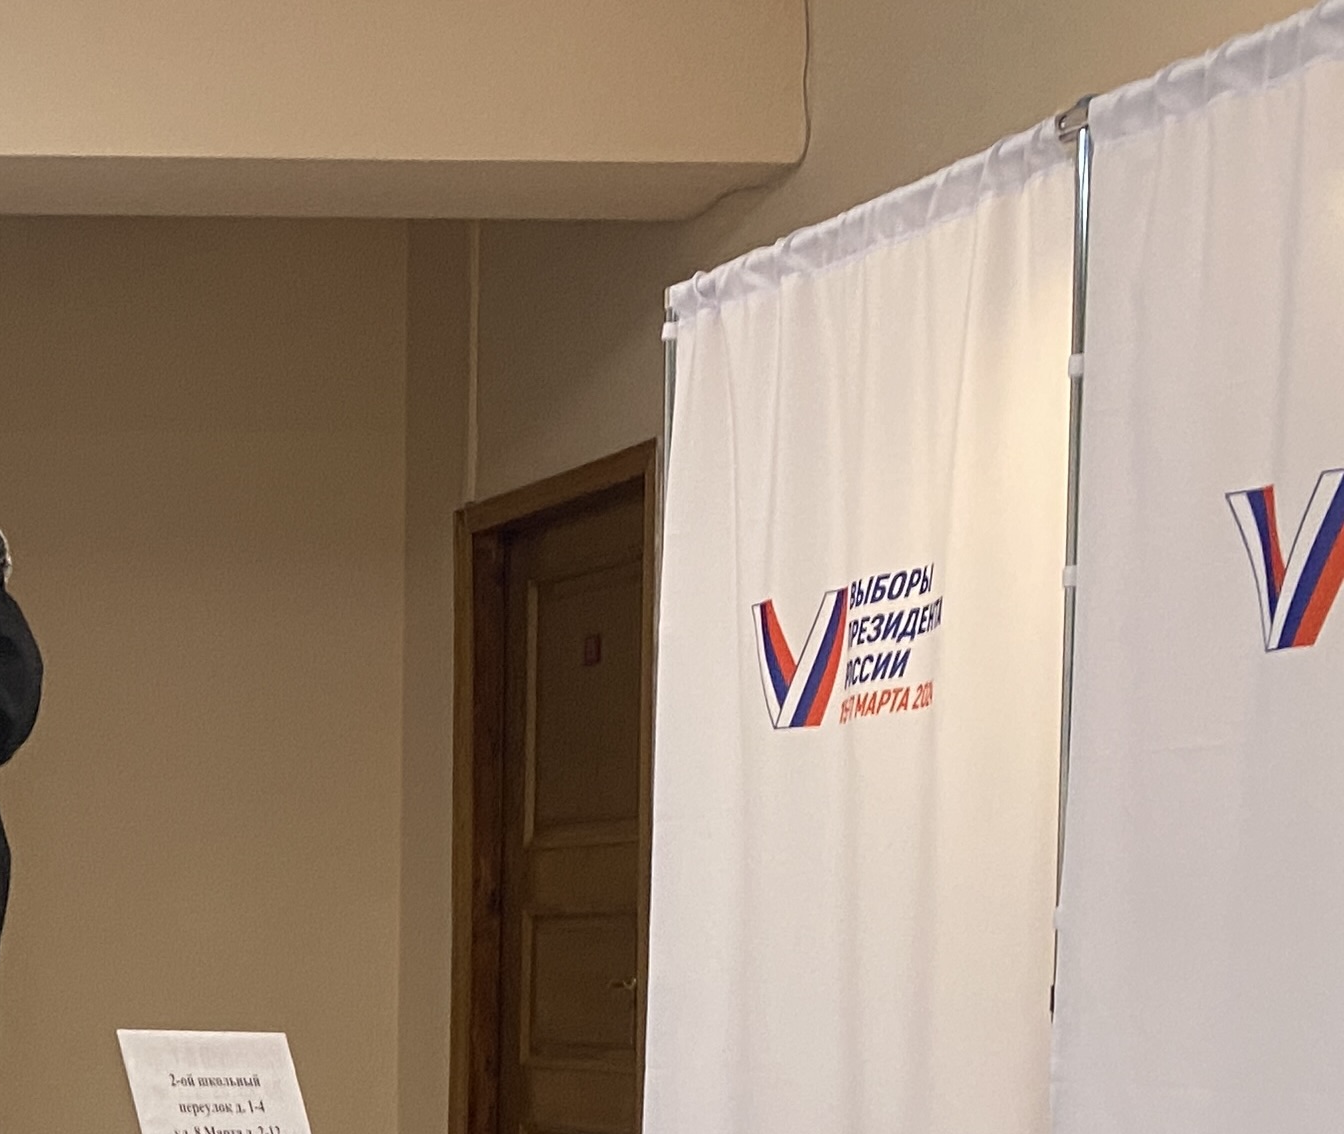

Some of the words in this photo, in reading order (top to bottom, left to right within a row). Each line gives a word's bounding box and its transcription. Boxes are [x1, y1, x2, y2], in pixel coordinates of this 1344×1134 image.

[849, 562, 934, 610] ВЫБОРЫ
[855, 687, 910, 718] МАРТА
[169, 1073, 195, 1087] 2-ой
[197, 1073, 261, 1087] школьный
[179, 1103, 233, 1117] переулок
[248, 1100, 265, 1113] 1-4
